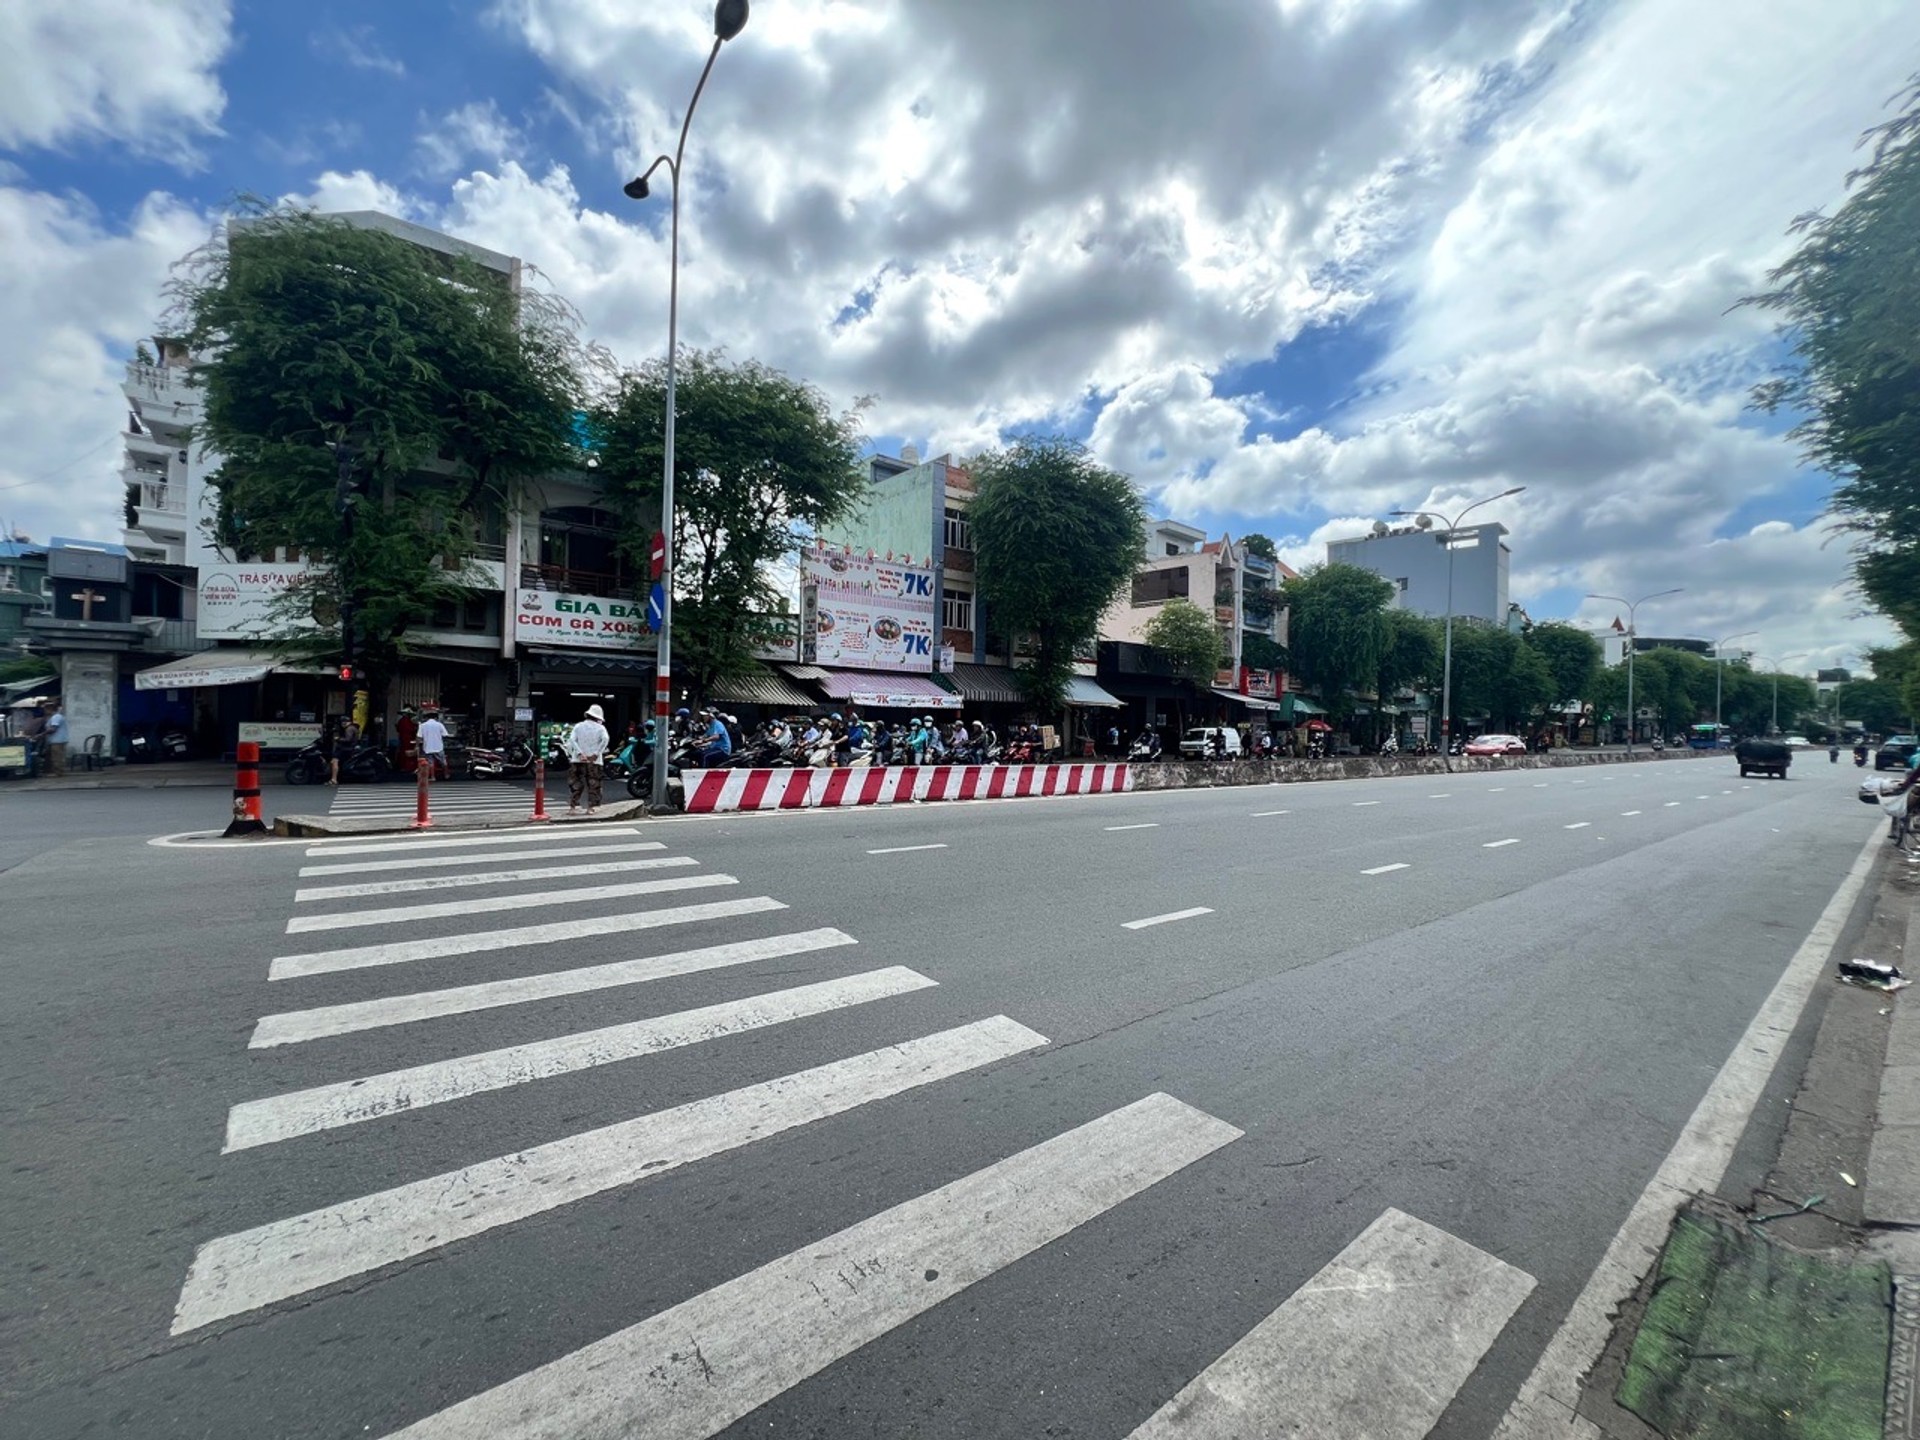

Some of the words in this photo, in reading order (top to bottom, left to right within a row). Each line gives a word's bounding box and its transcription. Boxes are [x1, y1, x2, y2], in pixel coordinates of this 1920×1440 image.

[239, 572, 259, 584] TRÀ
[262, 572, 284, 584] SỮA
[904, 572, 931, 597] 7K
[555, 599, 602, 616] GIA
[518, 614, 562, 627] CƠM
[570, 616, 594, 630] GÀ
[903, 633, 930, 656] 7K
[876, 694, 889, 705] 7K
